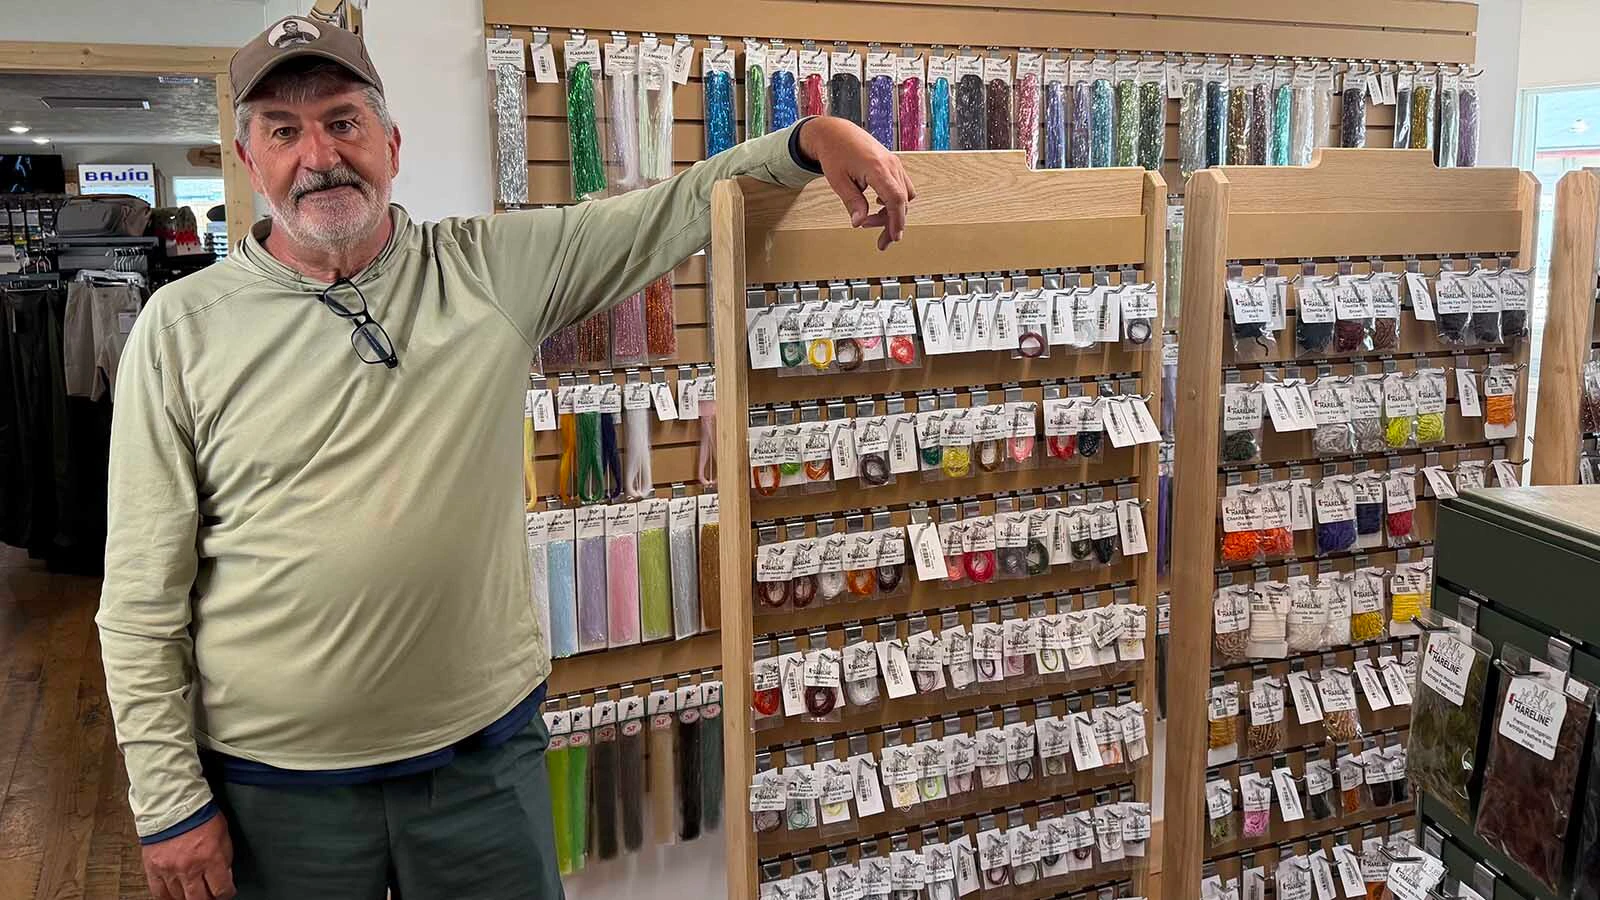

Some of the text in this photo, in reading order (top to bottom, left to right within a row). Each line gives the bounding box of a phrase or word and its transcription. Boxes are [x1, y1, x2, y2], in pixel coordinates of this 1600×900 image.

[85, 168, 149, 181] BAJÍO
[1433, 653, 1460, 676] HARELINE
[1514, 701, 1552, 728] HARELINE
